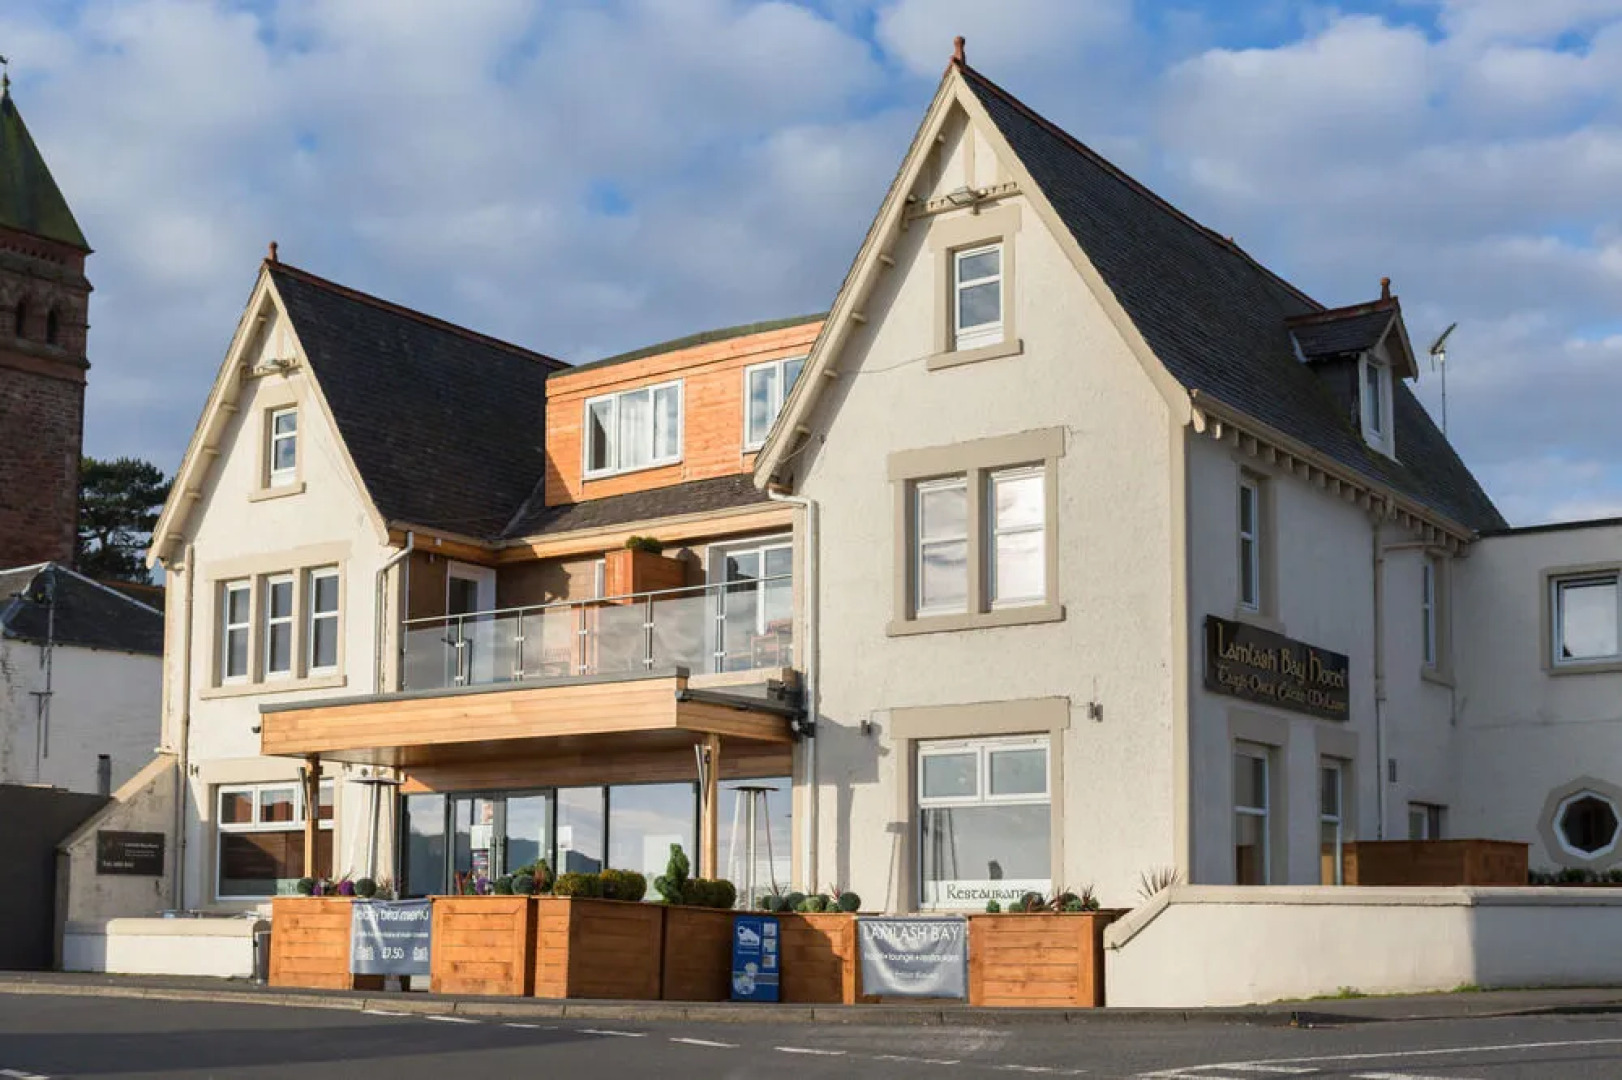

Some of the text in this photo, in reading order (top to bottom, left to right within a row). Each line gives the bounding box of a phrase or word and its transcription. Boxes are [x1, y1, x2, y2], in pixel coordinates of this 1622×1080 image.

[1217, 622, 1277, 672] Lamlash
[1282, 648, 1305, 685] Bay
[864, 926, 959, 941] LAMLASH BAY
